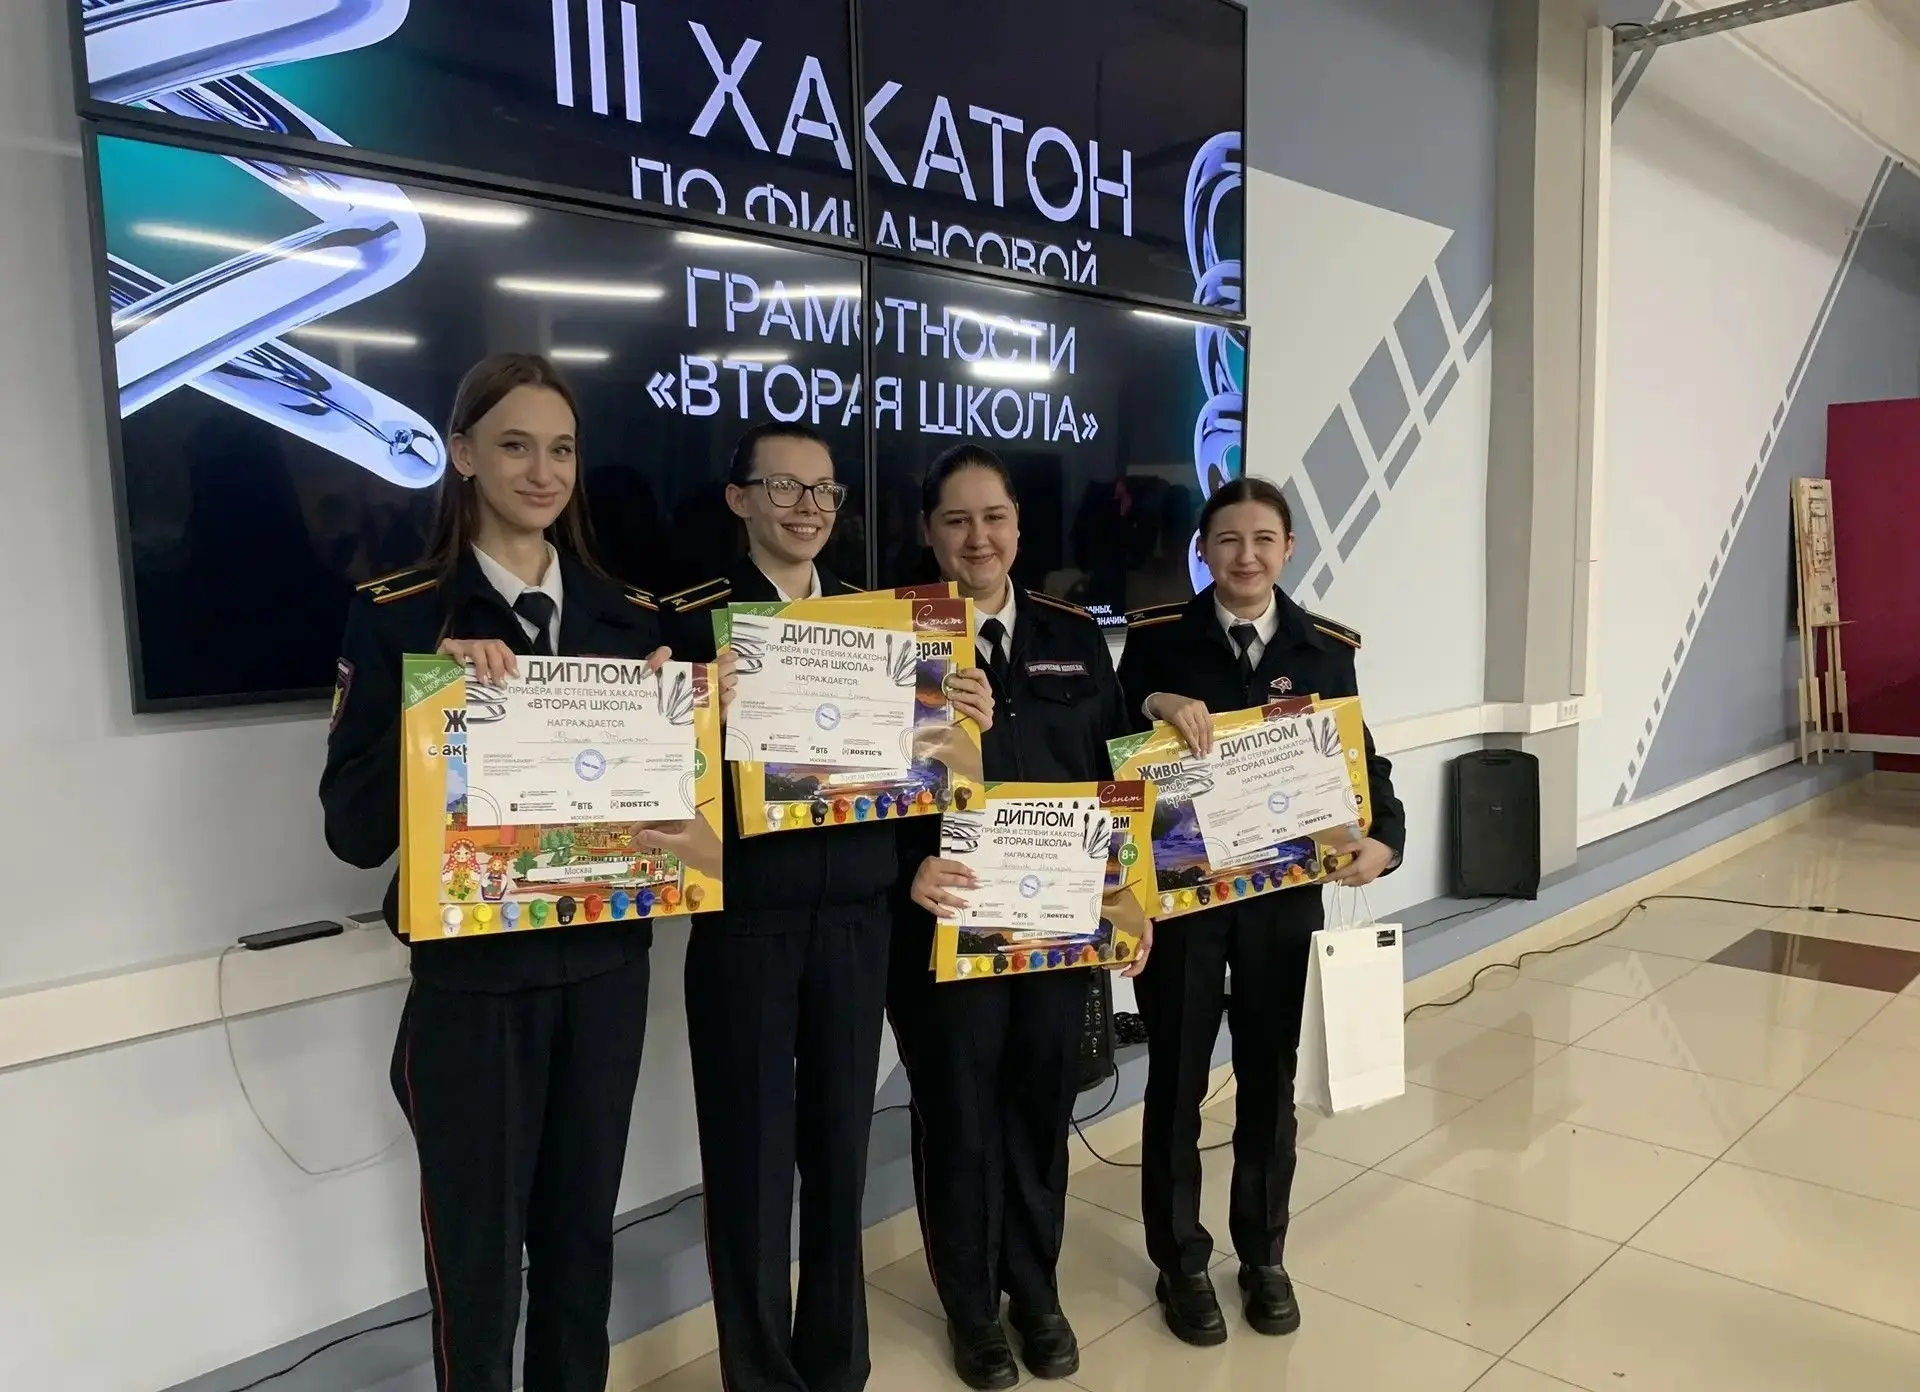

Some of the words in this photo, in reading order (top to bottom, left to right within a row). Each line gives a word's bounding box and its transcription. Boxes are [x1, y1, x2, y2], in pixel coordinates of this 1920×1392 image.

[688, 20, 1133, 236] ХАКАТОН
[631, 156, 726, 216] ПО
[686, 266, 1076, 374] ГРАМОТНОСТИ
[919, 381, 1099, 443] ШКОЛА»
[781, 623, 875, 650] ДИПЛОМ
[766, 643, 801, 654] ПРИЗЁРА
[810, 648, 846, 659] СТЕПЕНИ
[847, 651, 887, 662] ХАКАТОНА
[525, 660, 641, 686] ДИПЛОМ
[781, 655, 829, 669] «ВТОРАЯ
[830, 659, 874, 673] ШКОЛА»
[795, 673, 858, 686] НАГРАЖДАЕТСЯ
[508, 686, 552, 697] ПРИЗЁРА
[563, 686, 608, 698] СТЕПЕНИ
[609, 688, 659, 699] ХАКАТОНА
[527, 698, 587, 711] «ВТОРАЯ
[590, 700, 643, 712] ШКОЛА»
[547, 718, 625, 729] НАГРАЖДАЕТСЯ
[1219, 723, 1299, 760] ДИПЛОМ
[1226, 759, 1267, 777] «ВТОРАЯ
[1267, 749, 1305, 765] ШКОЛА»
[577, 801, 593, 811] ВТБ
[620, 799, 660, 809] ROSTIC'S
[994, 809, 1075, 828] ДИПЛОМ
[981, 826, 1011, 835] ПРИЗЁРА
[1019, 828, 1049, 837] СТЕПЕНИ
[1050, 830, 1084, 838] ХАКАТОНА
[993, 837, 1033, 847] «ВТОРАЯ
[1035, 838, 1073, 848] ШКОЛА»
[1121, 849, 1136, 860] 8+
[564, 866, 593, 877] Москва
